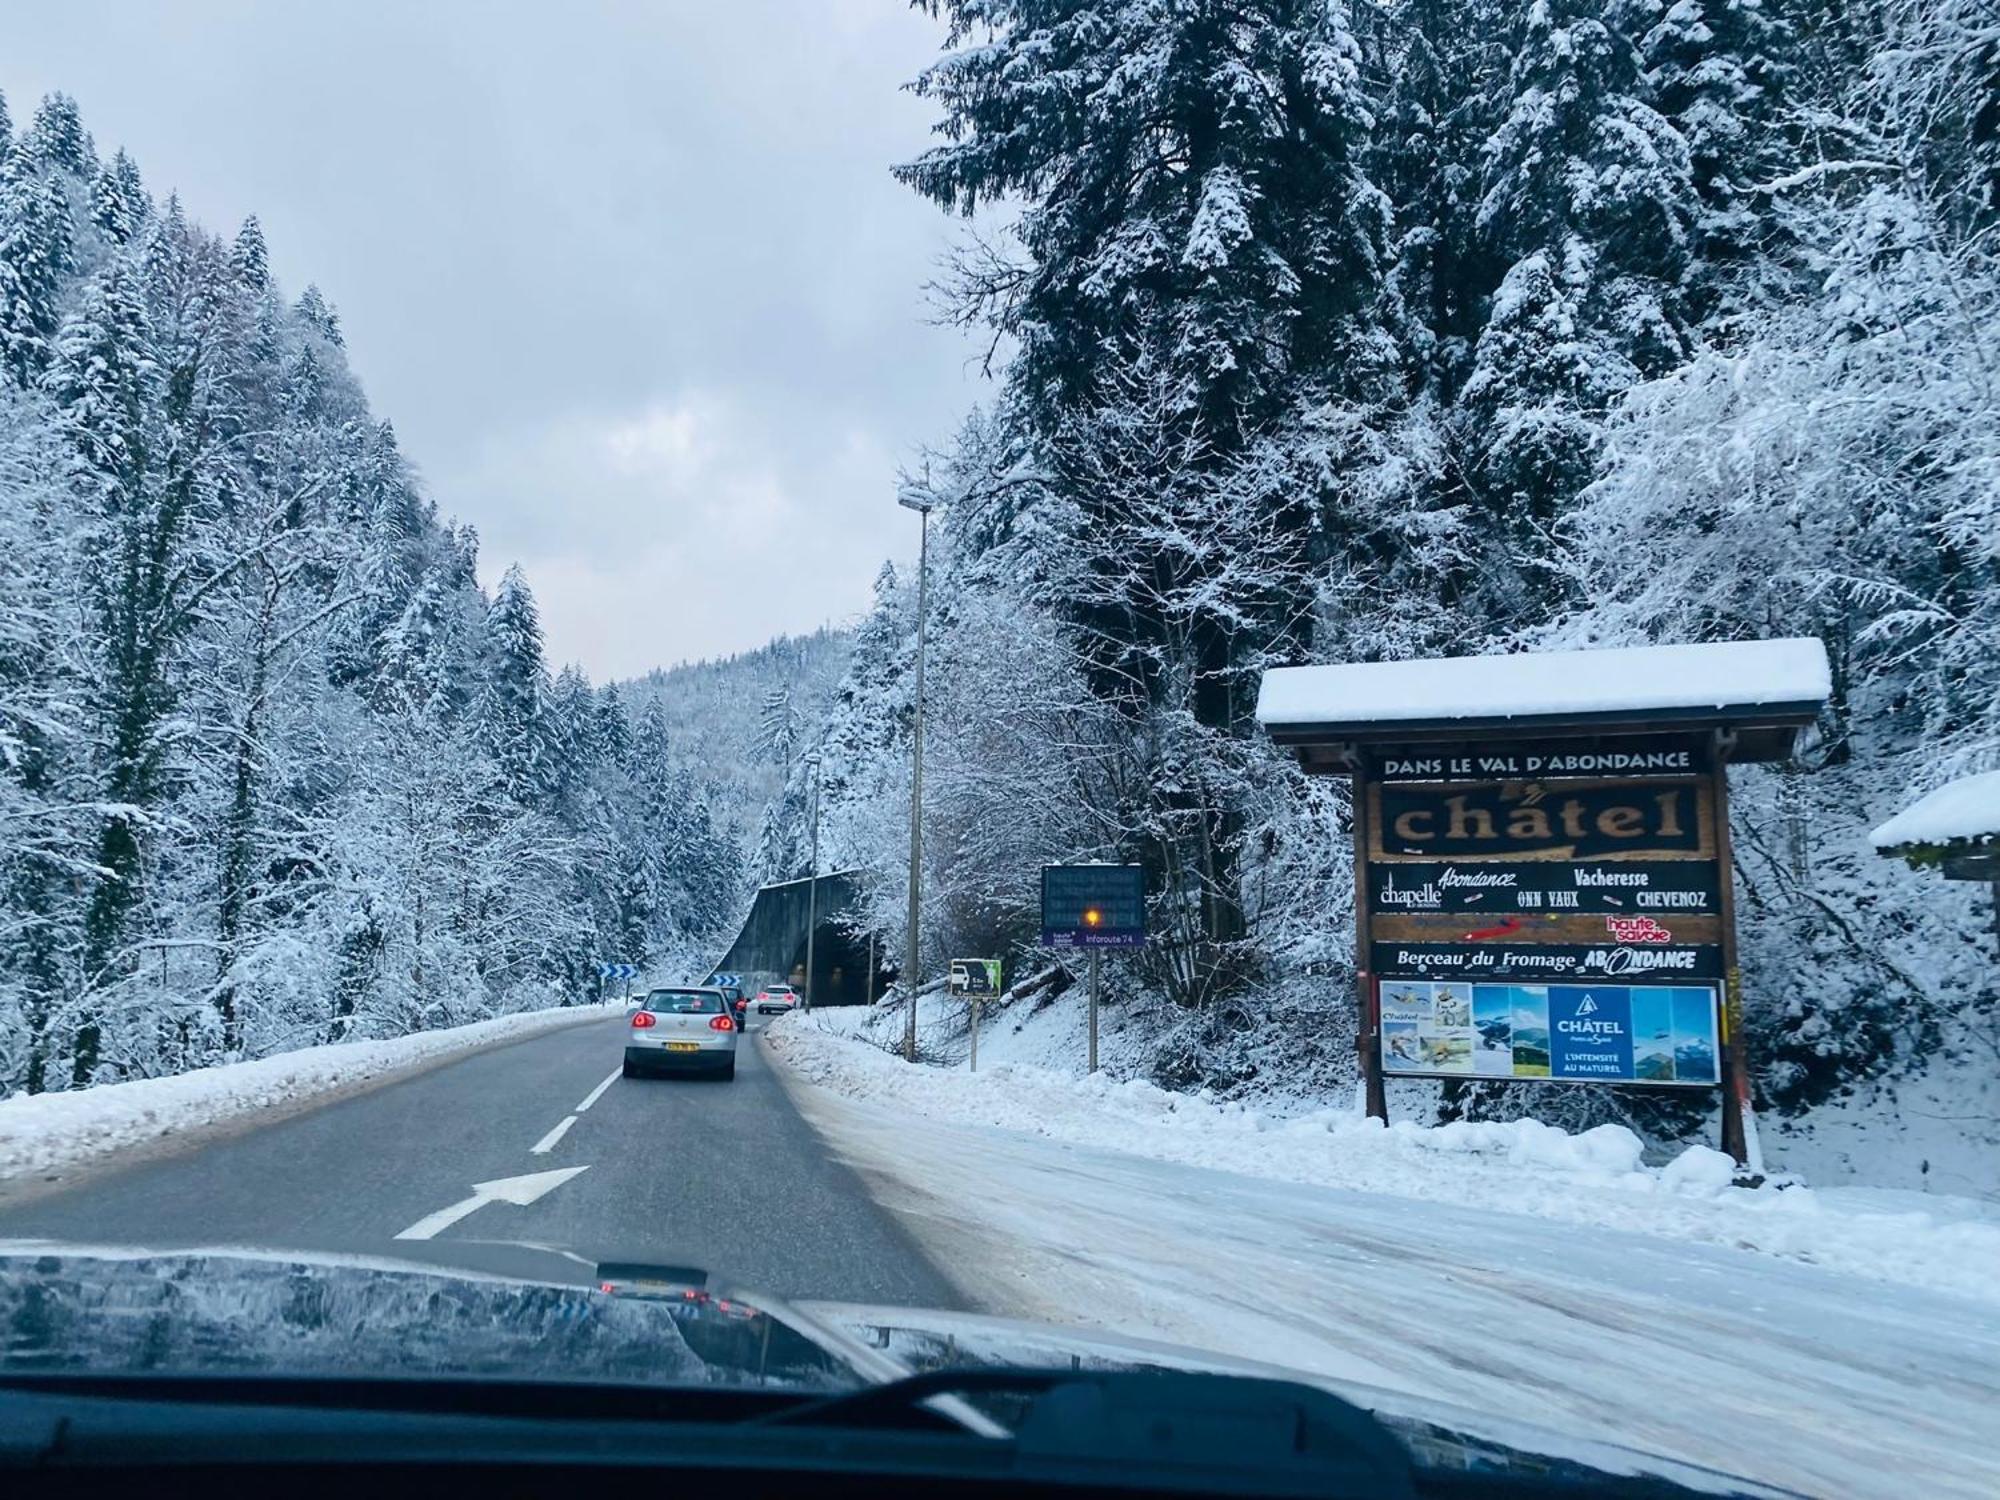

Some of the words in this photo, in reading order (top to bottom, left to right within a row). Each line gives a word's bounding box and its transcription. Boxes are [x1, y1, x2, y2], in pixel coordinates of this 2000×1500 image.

[1384, 759, 1442, 775] DANS
[1450, 758, 1472, 773] LE
[1478, 757, 1519, 772] VAL
[1526, 752, 1690, 771] D'ABONDANCE
[1438, 867, 1517, 890] Abondance
[1574, 868, 1649, 886] Vacheresse
[1380, 871, 1442, 908] chapelle
[1636, 891, 1707, 907] CHEVENOZ
[1607, 916, 1655, 931] haute
[1616, 928, 1670, 942] savoie
[1397, 951, 1464, 965] Berceau
[1471, 951, 1494, 966] du
[1502, 952, 1576, 972] Fromage
[1585, 946, 1696, 975] ABONDANCE
[1557, 1018, 1624, 1034] CHÂTEL
[1563, 1063, 1577, 1072] AU
[1579, 1064, 1622, 1073] NATUREL
